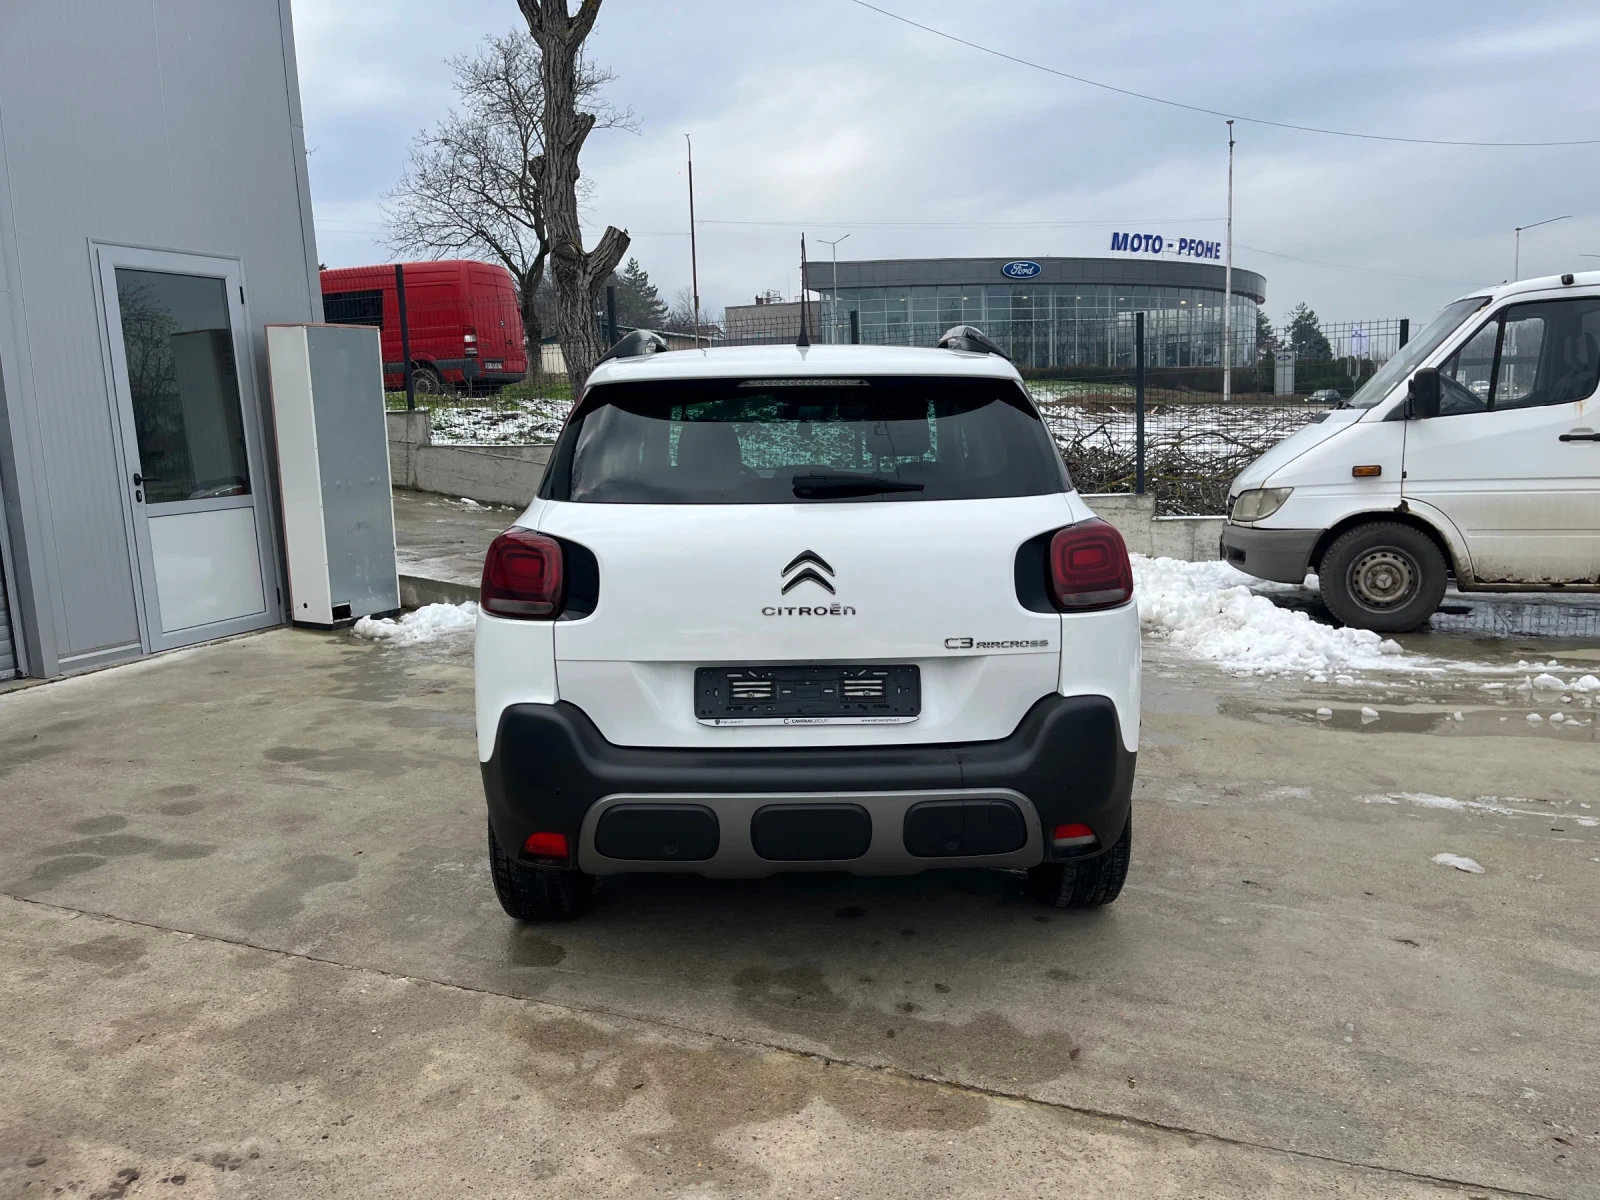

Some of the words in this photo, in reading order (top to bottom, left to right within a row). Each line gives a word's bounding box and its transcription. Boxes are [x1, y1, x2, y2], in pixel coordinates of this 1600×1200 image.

[1111, 232, 1163, 254] MOTO
[1177, 238, 1221, 260] PFOHE
[1010, 263, 1035, 275] Ford
[944, 637, 974, 650] C3
[975, 639, 1050, 649] AIRCROSS
